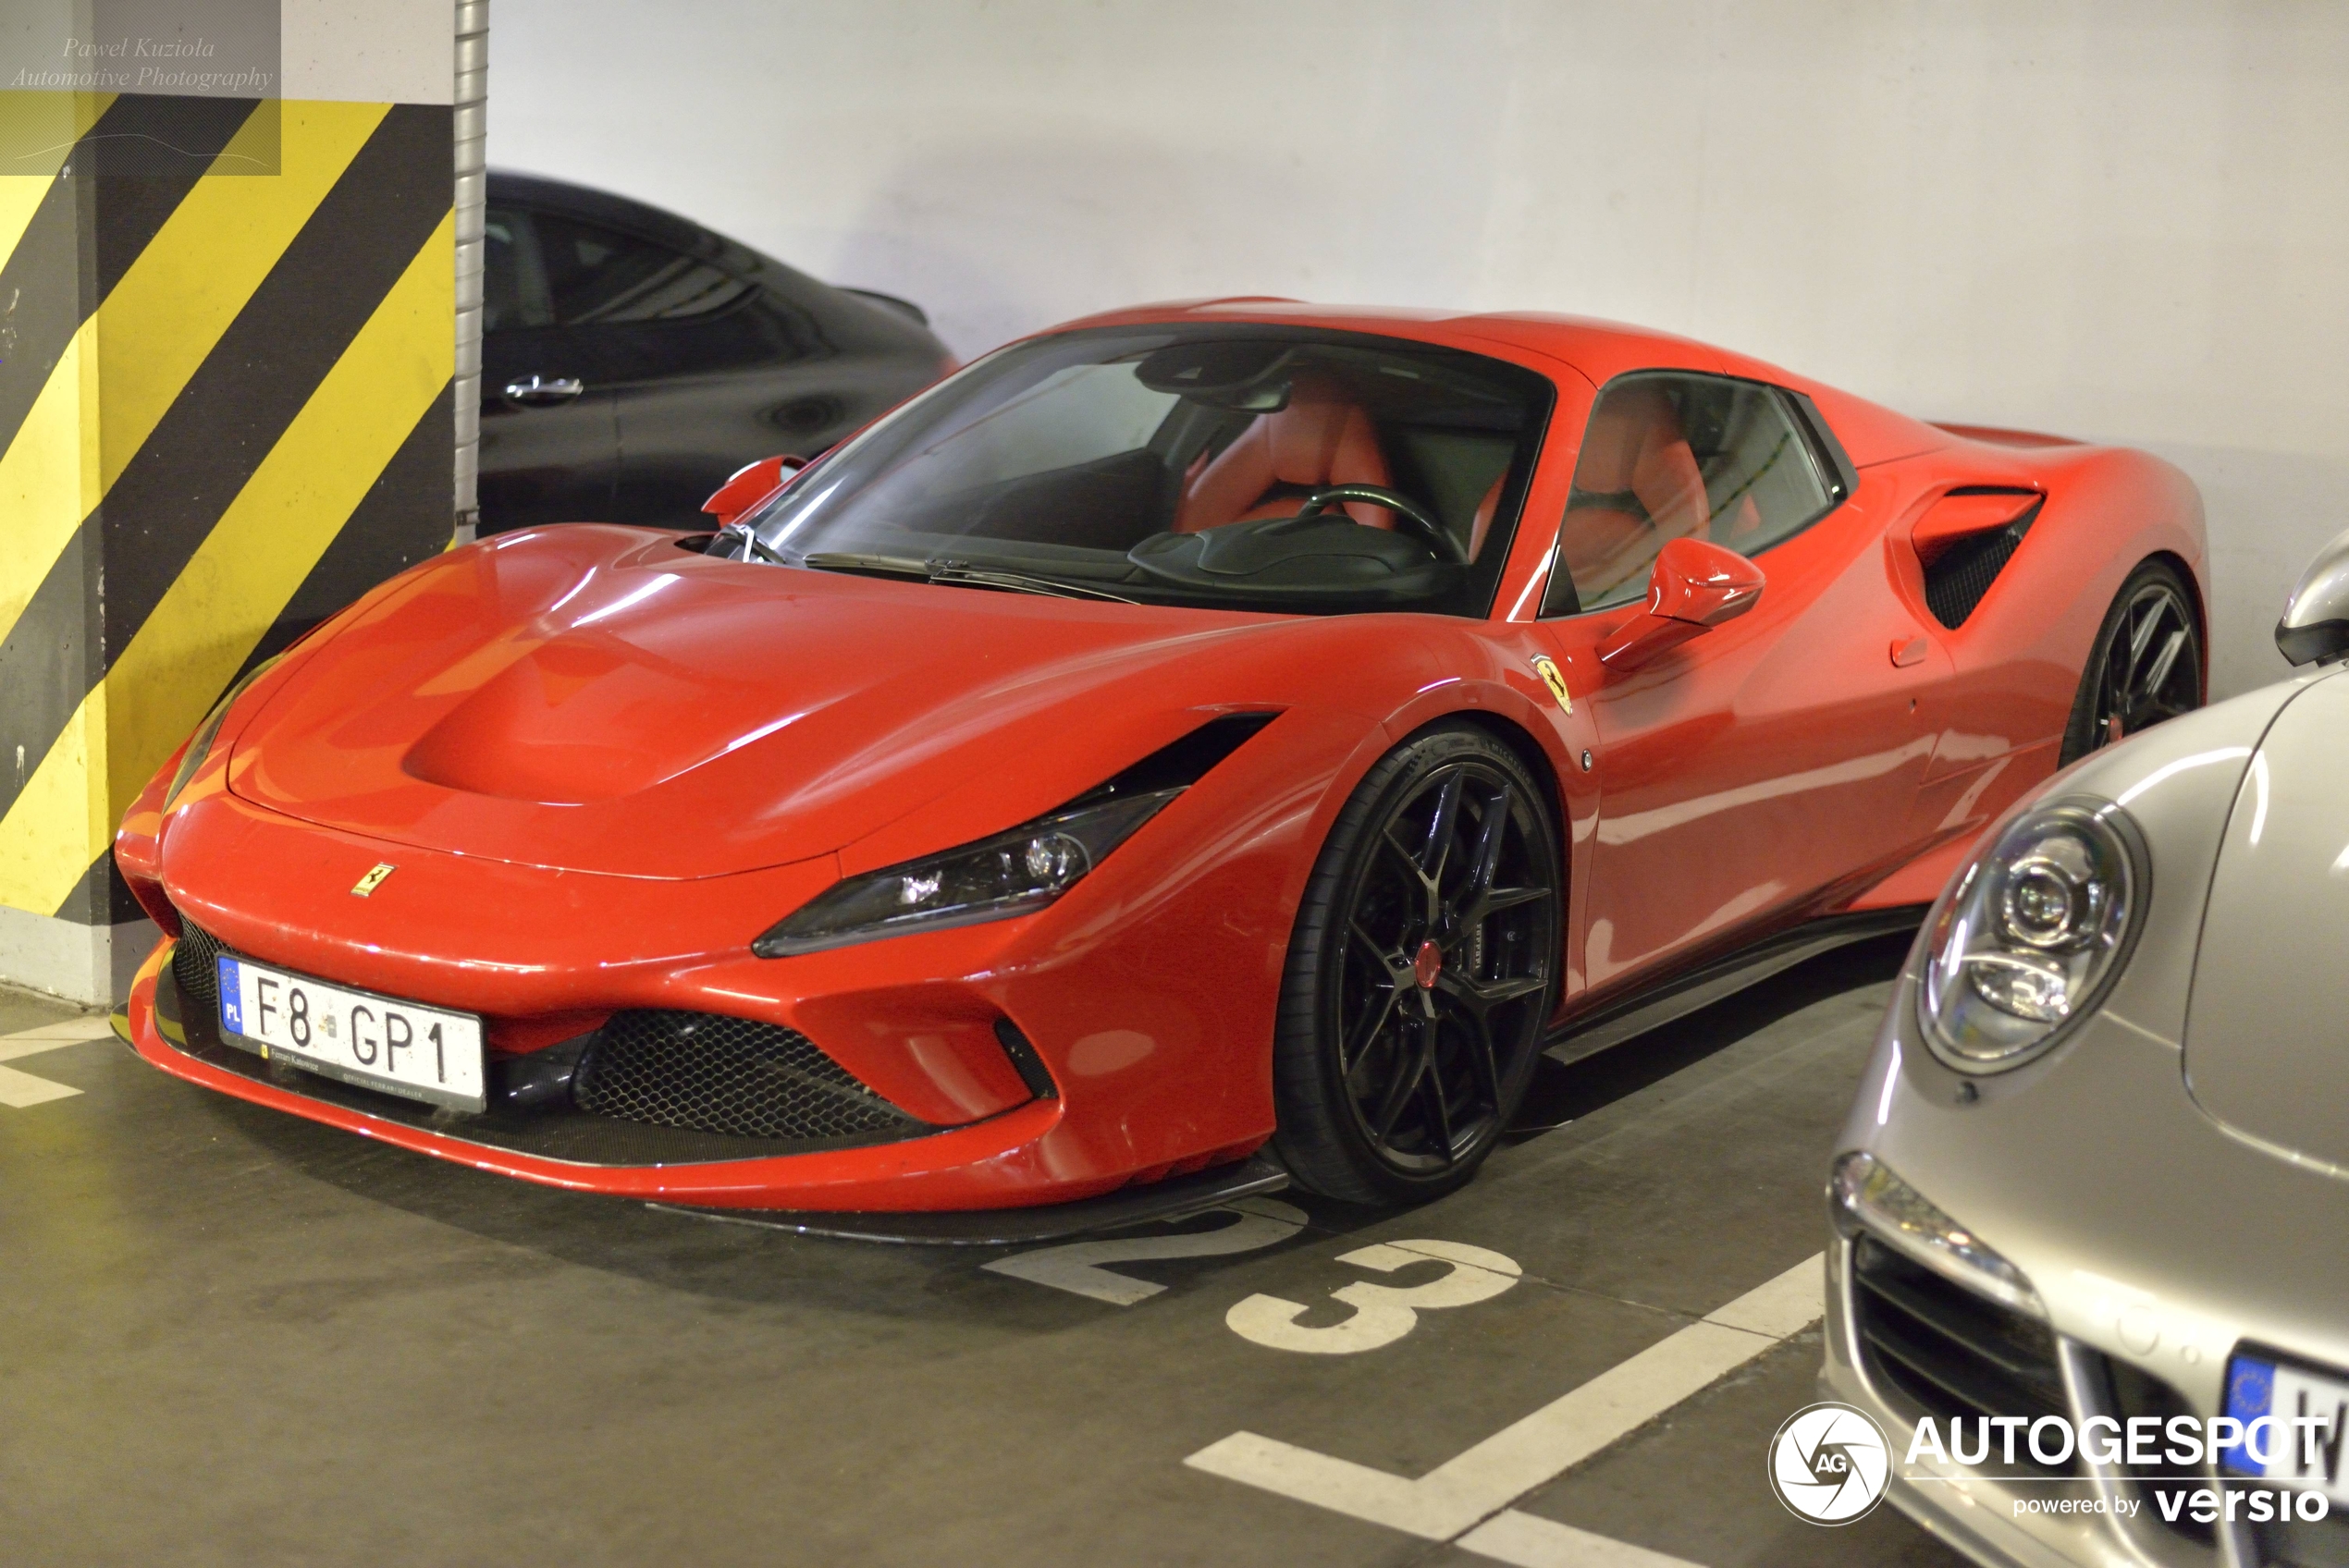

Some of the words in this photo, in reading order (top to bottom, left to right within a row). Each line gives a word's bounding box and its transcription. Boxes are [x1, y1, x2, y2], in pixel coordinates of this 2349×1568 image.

[226, 1002, 240, 1022] PL
[257, 976, 311, 1047] F8
[351, 1004, 446, 1084] GP1
[271, 1047, 290, 1062] Ferrari
[291, 1054, 319, 1071] Katowice
[343, 1072, 370, 1086] OFFICIAL
[370, 1080, 397, 1092] FERRARI
[398, 1087, 423, 1098] DEALER
